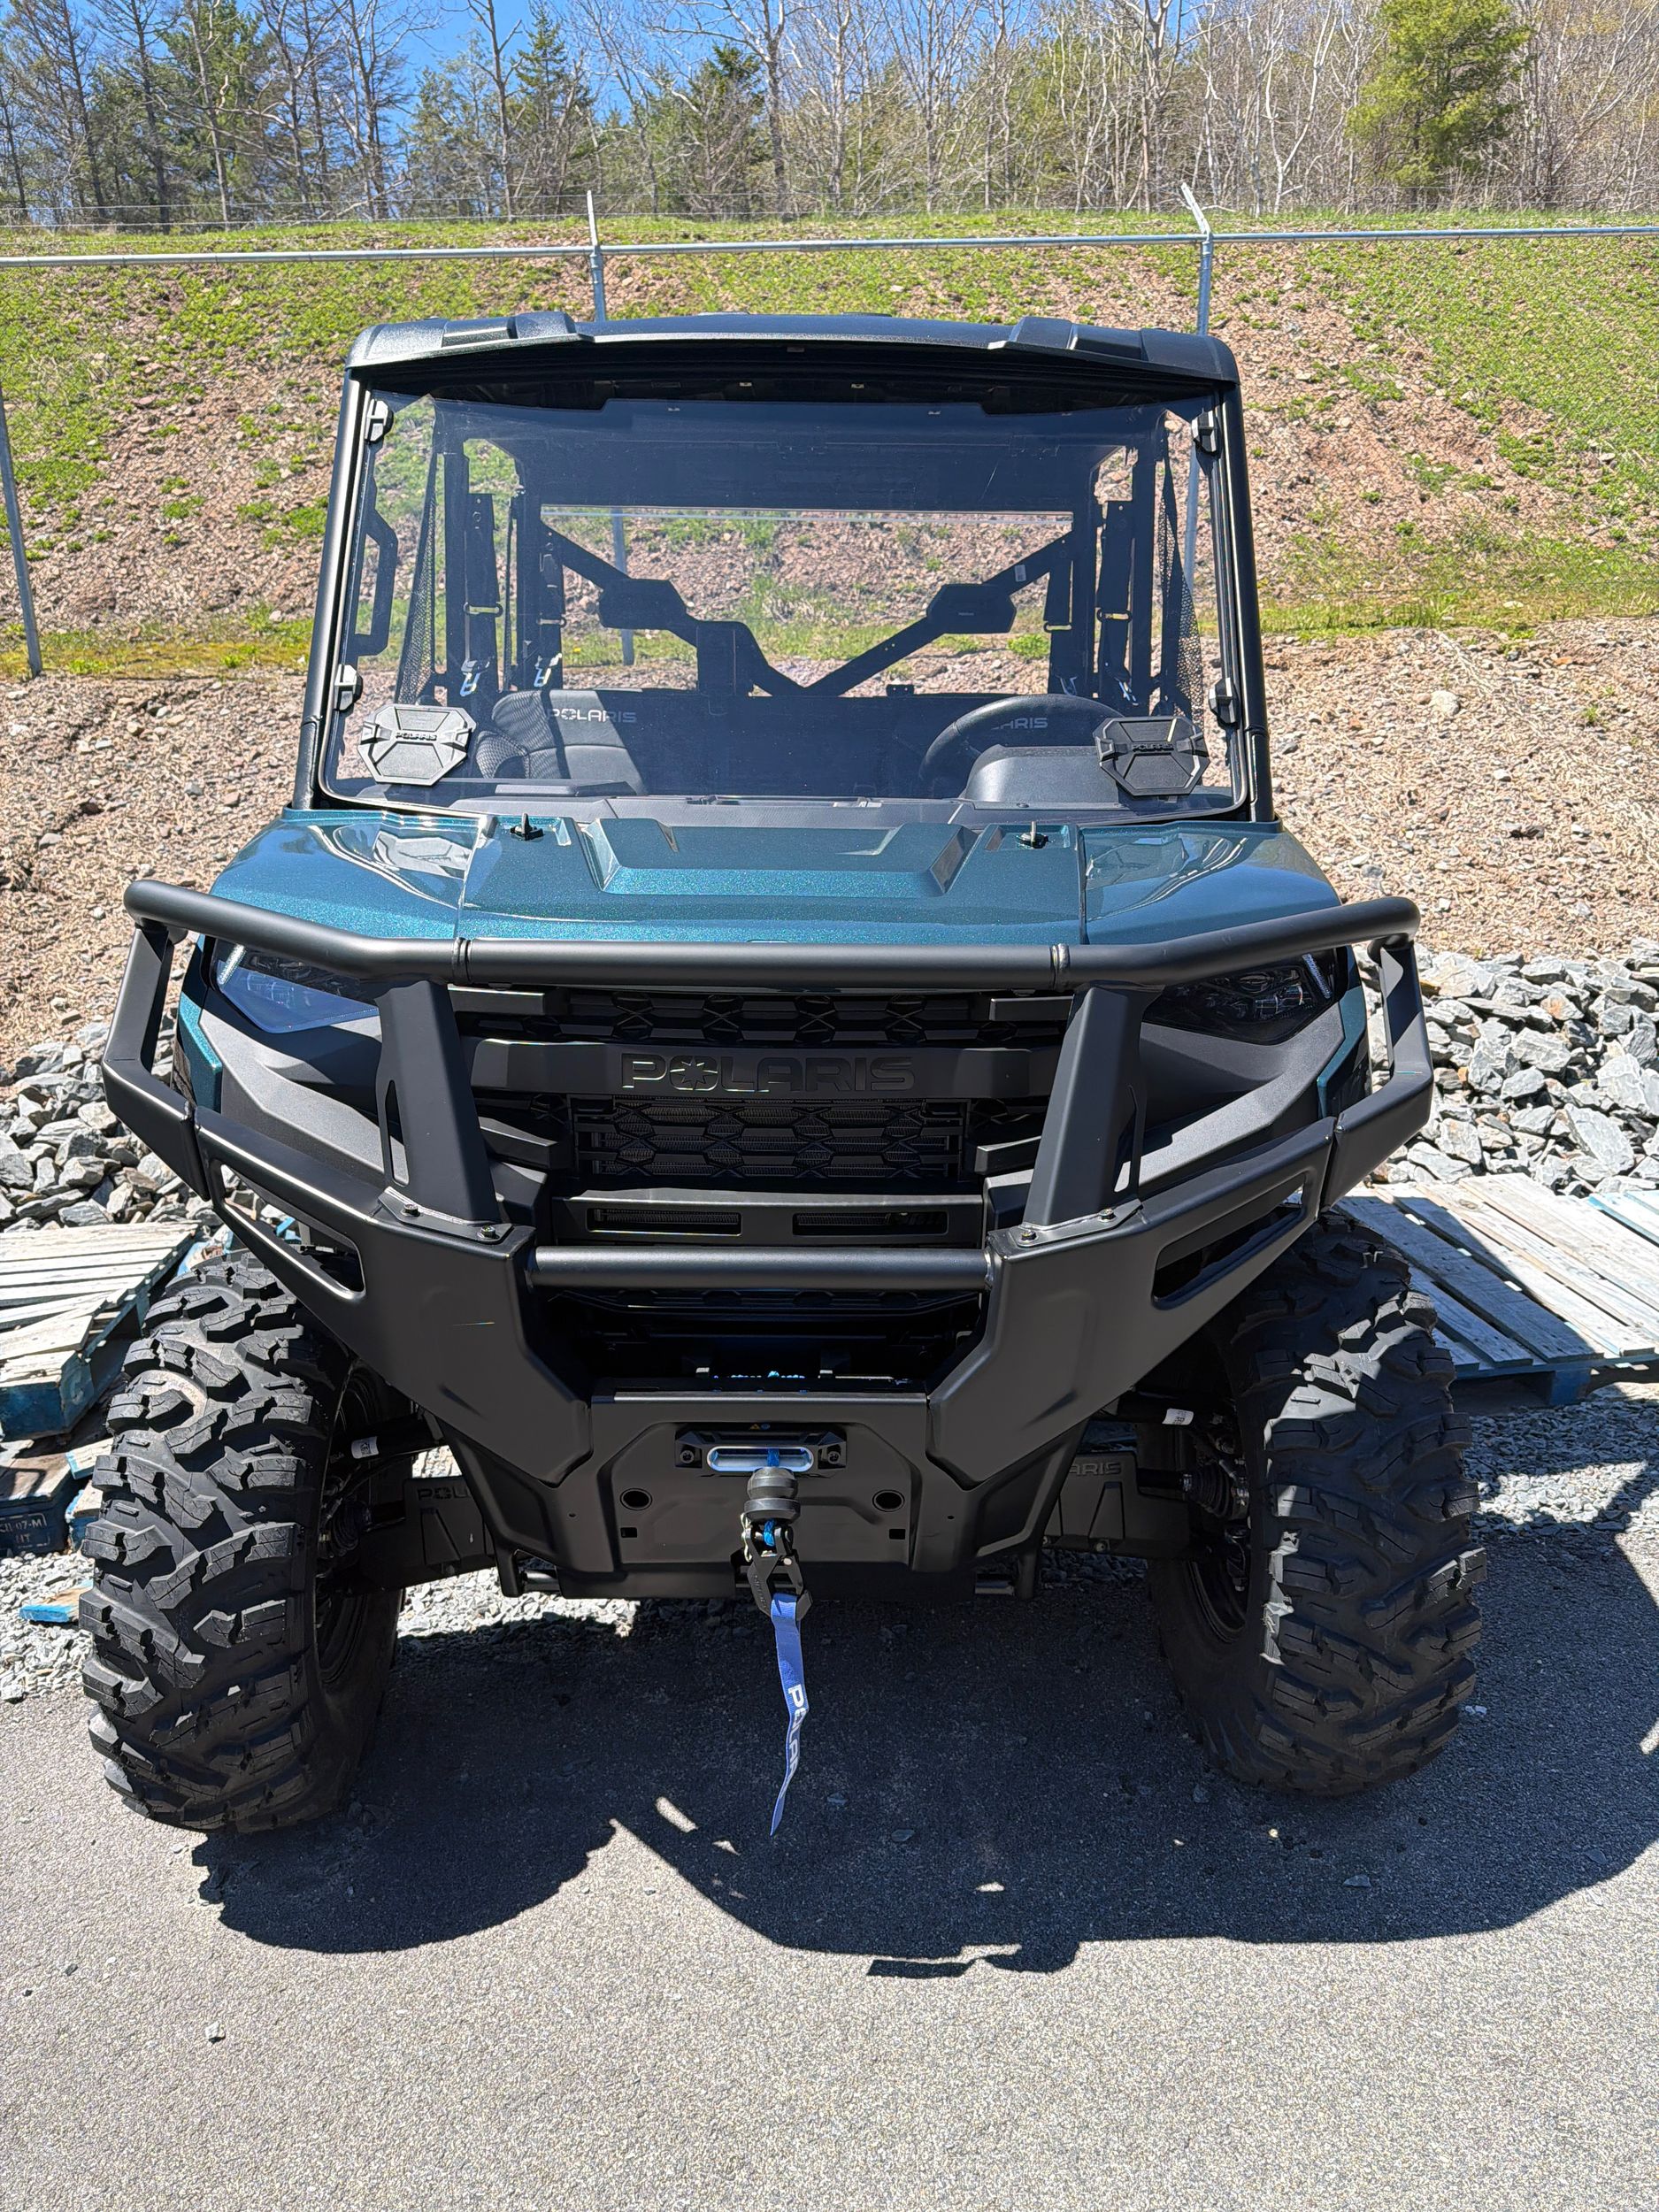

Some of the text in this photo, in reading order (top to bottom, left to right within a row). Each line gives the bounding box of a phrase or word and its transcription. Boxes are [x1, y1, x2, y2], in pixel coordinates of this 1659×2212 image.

[548, 708, 637, 723] POLARIS
[992, 718, 1048, 730] ARIS
[621, 1053, 916, 1092] POLARIS
[417, 1486, 471, 1501] POL
